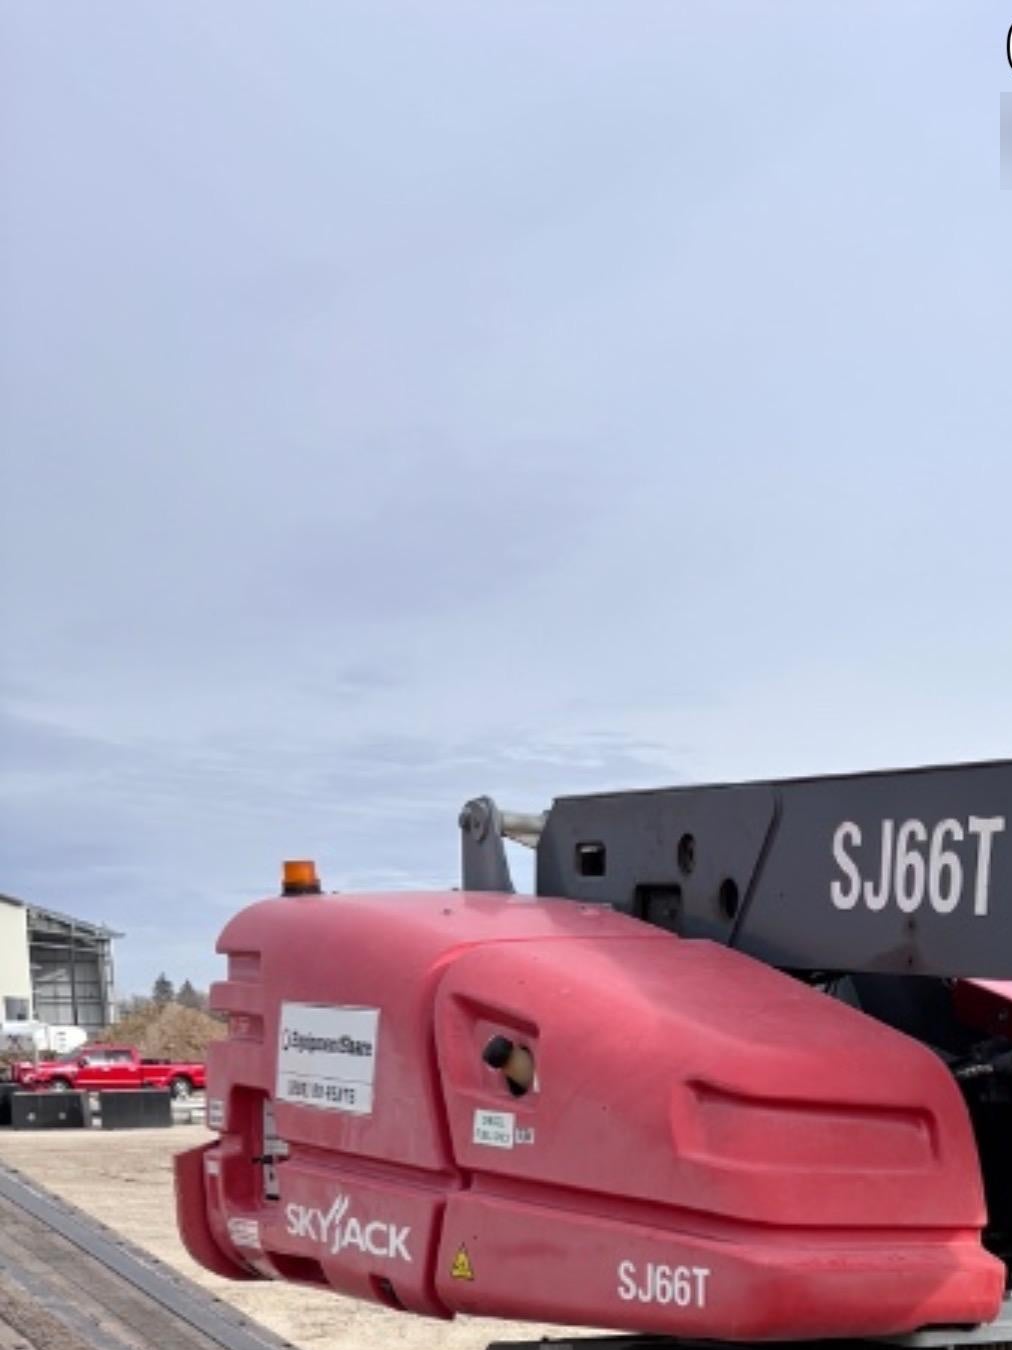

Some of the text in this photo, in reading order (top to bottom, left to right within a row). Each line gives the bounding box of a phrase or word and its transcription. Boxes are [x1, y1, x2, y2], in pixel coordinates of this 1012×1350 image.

[830, 815, 1006, 916] SJ66T
[285, 1192, 412, 1262] SKYJACK
[617, 1260, 710, 1309] SJ66T
